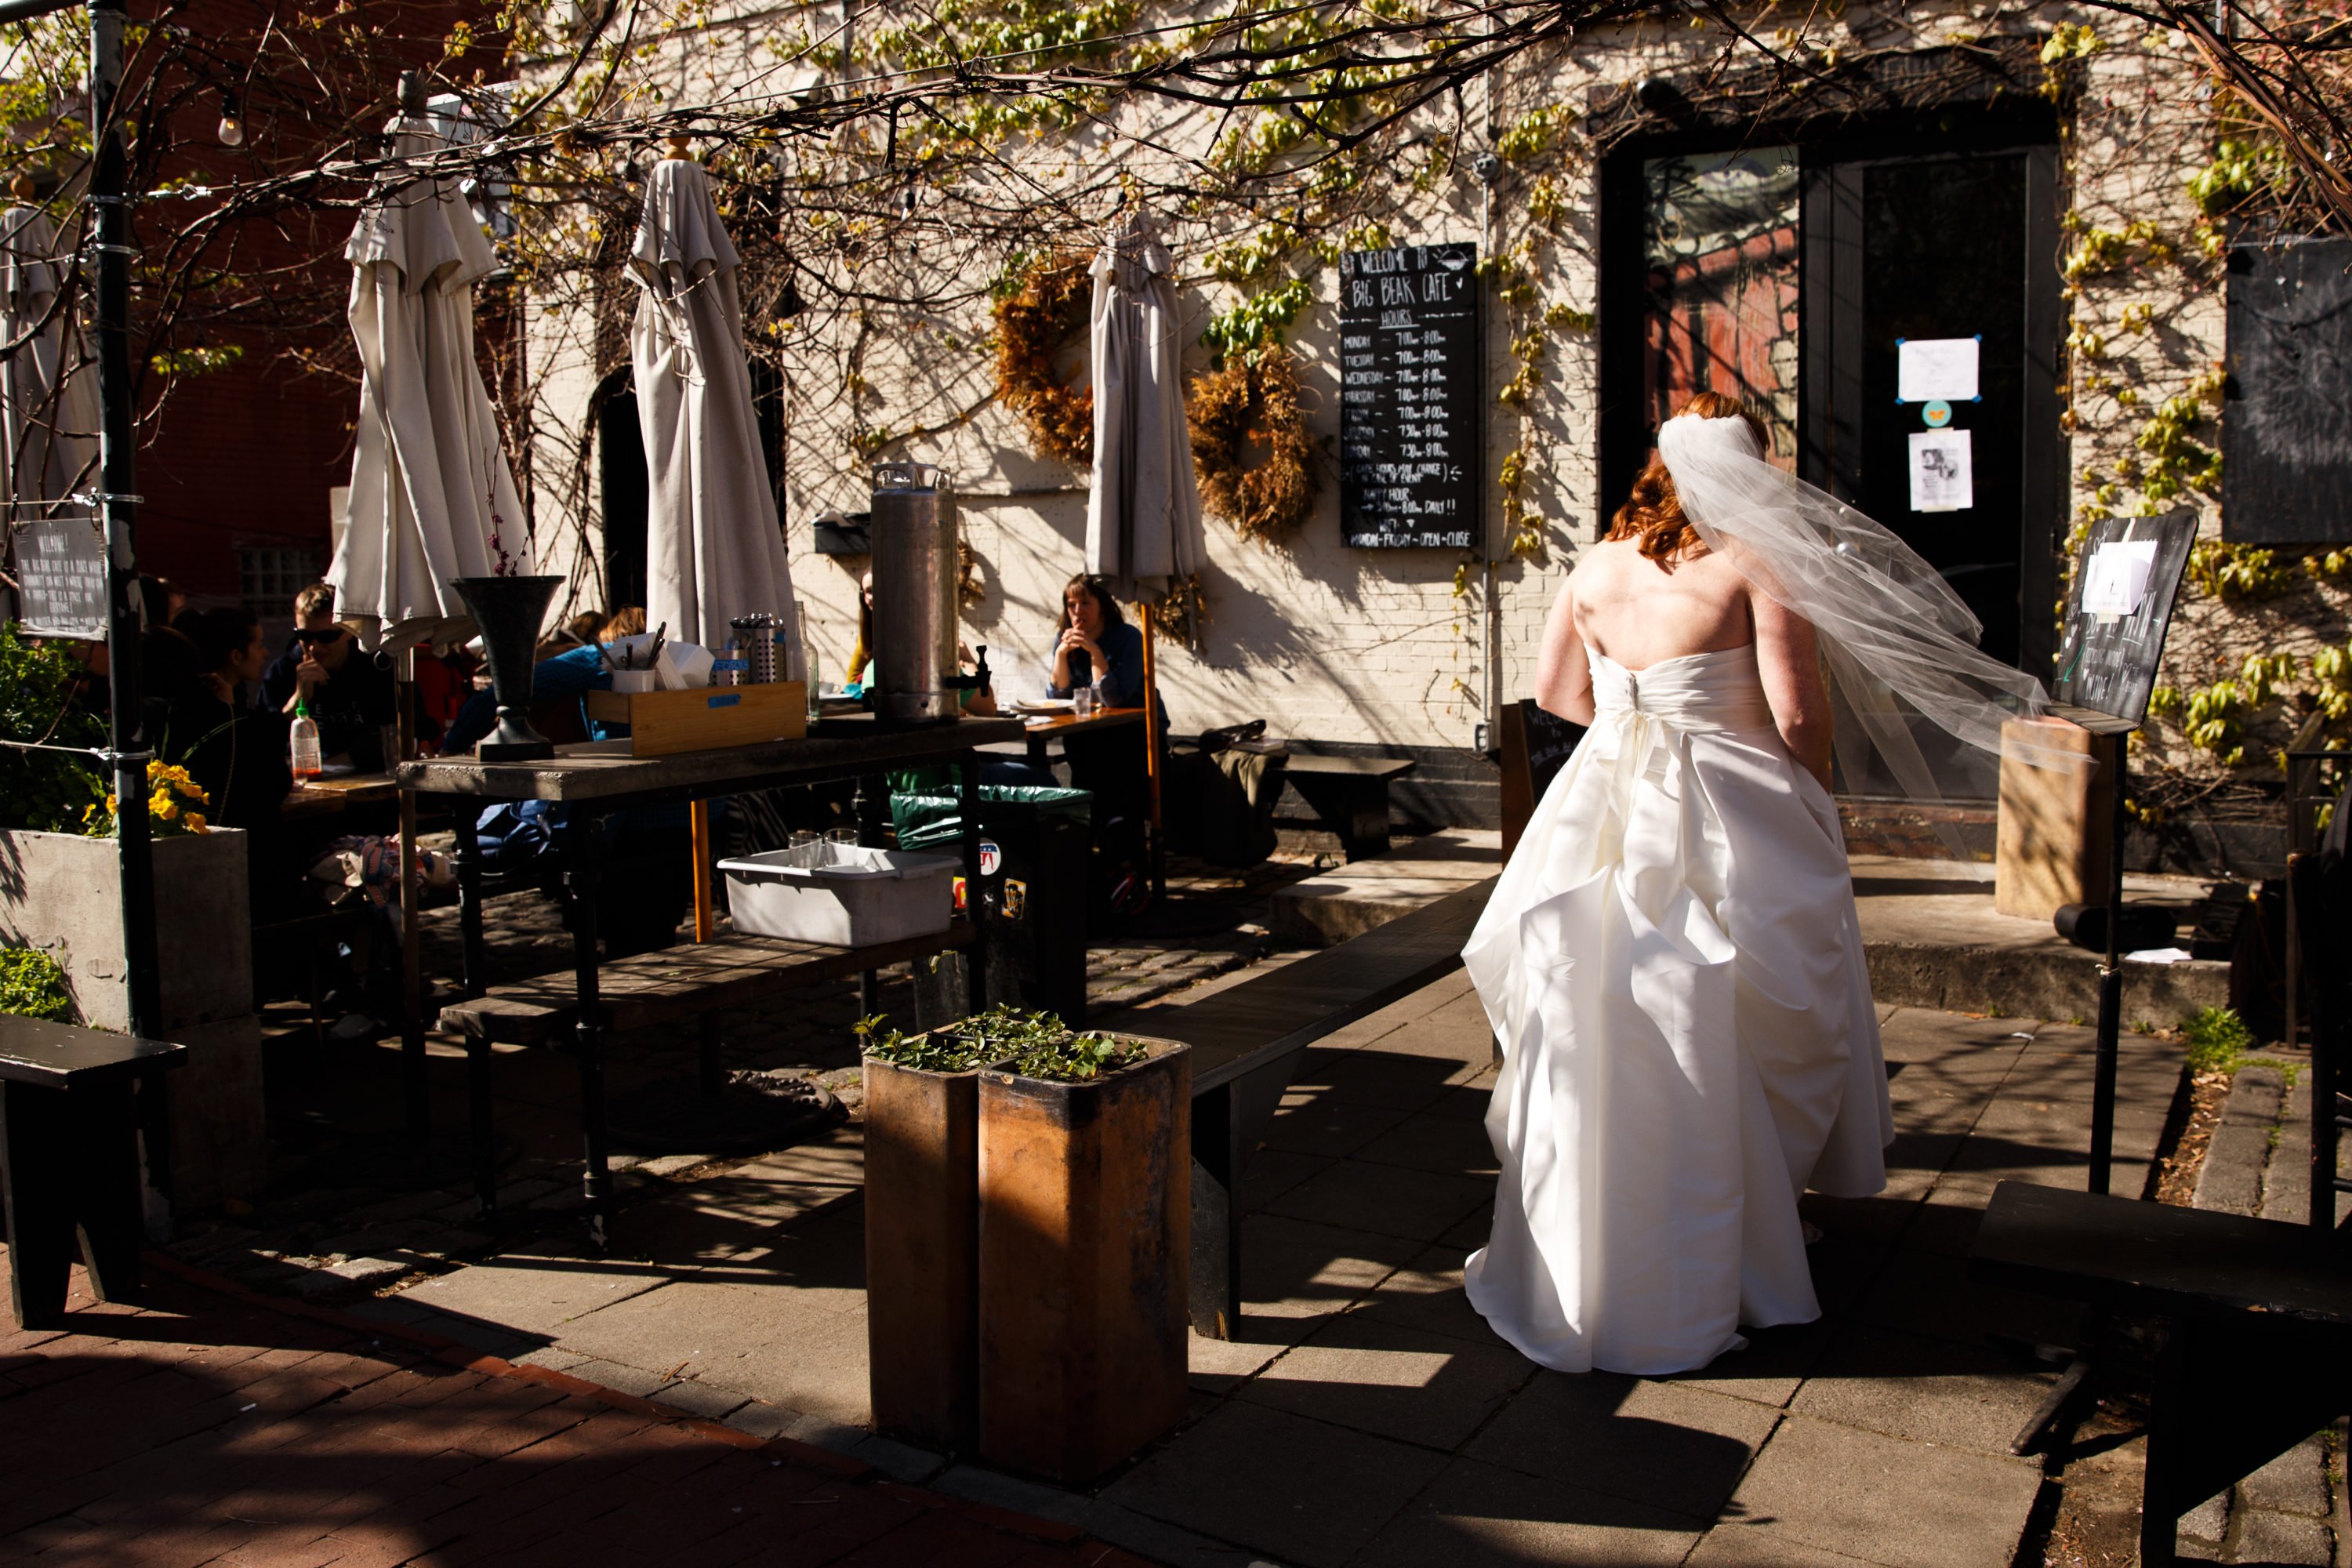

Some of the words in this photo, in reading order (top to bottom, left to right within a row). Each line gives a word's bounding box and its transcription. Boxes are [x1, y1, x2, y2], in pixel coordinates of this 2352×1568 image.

[1360, 248, 1408, 274] WELCOME
[1417, 247, 1428, 270] TO
[1352, 279, 1374, 308] BIG
[1381, 276, 1415, 307] BEAR
[1423, 272, 1452, 303] CAFE
[1381, 309, 1413, 326] HOURS
[1344, 336, 1370, 349] MONDAY
[1345, 353, 1374, 367] TUESDAY
[1345, 370, 1384, 385] WEDNESDAY
